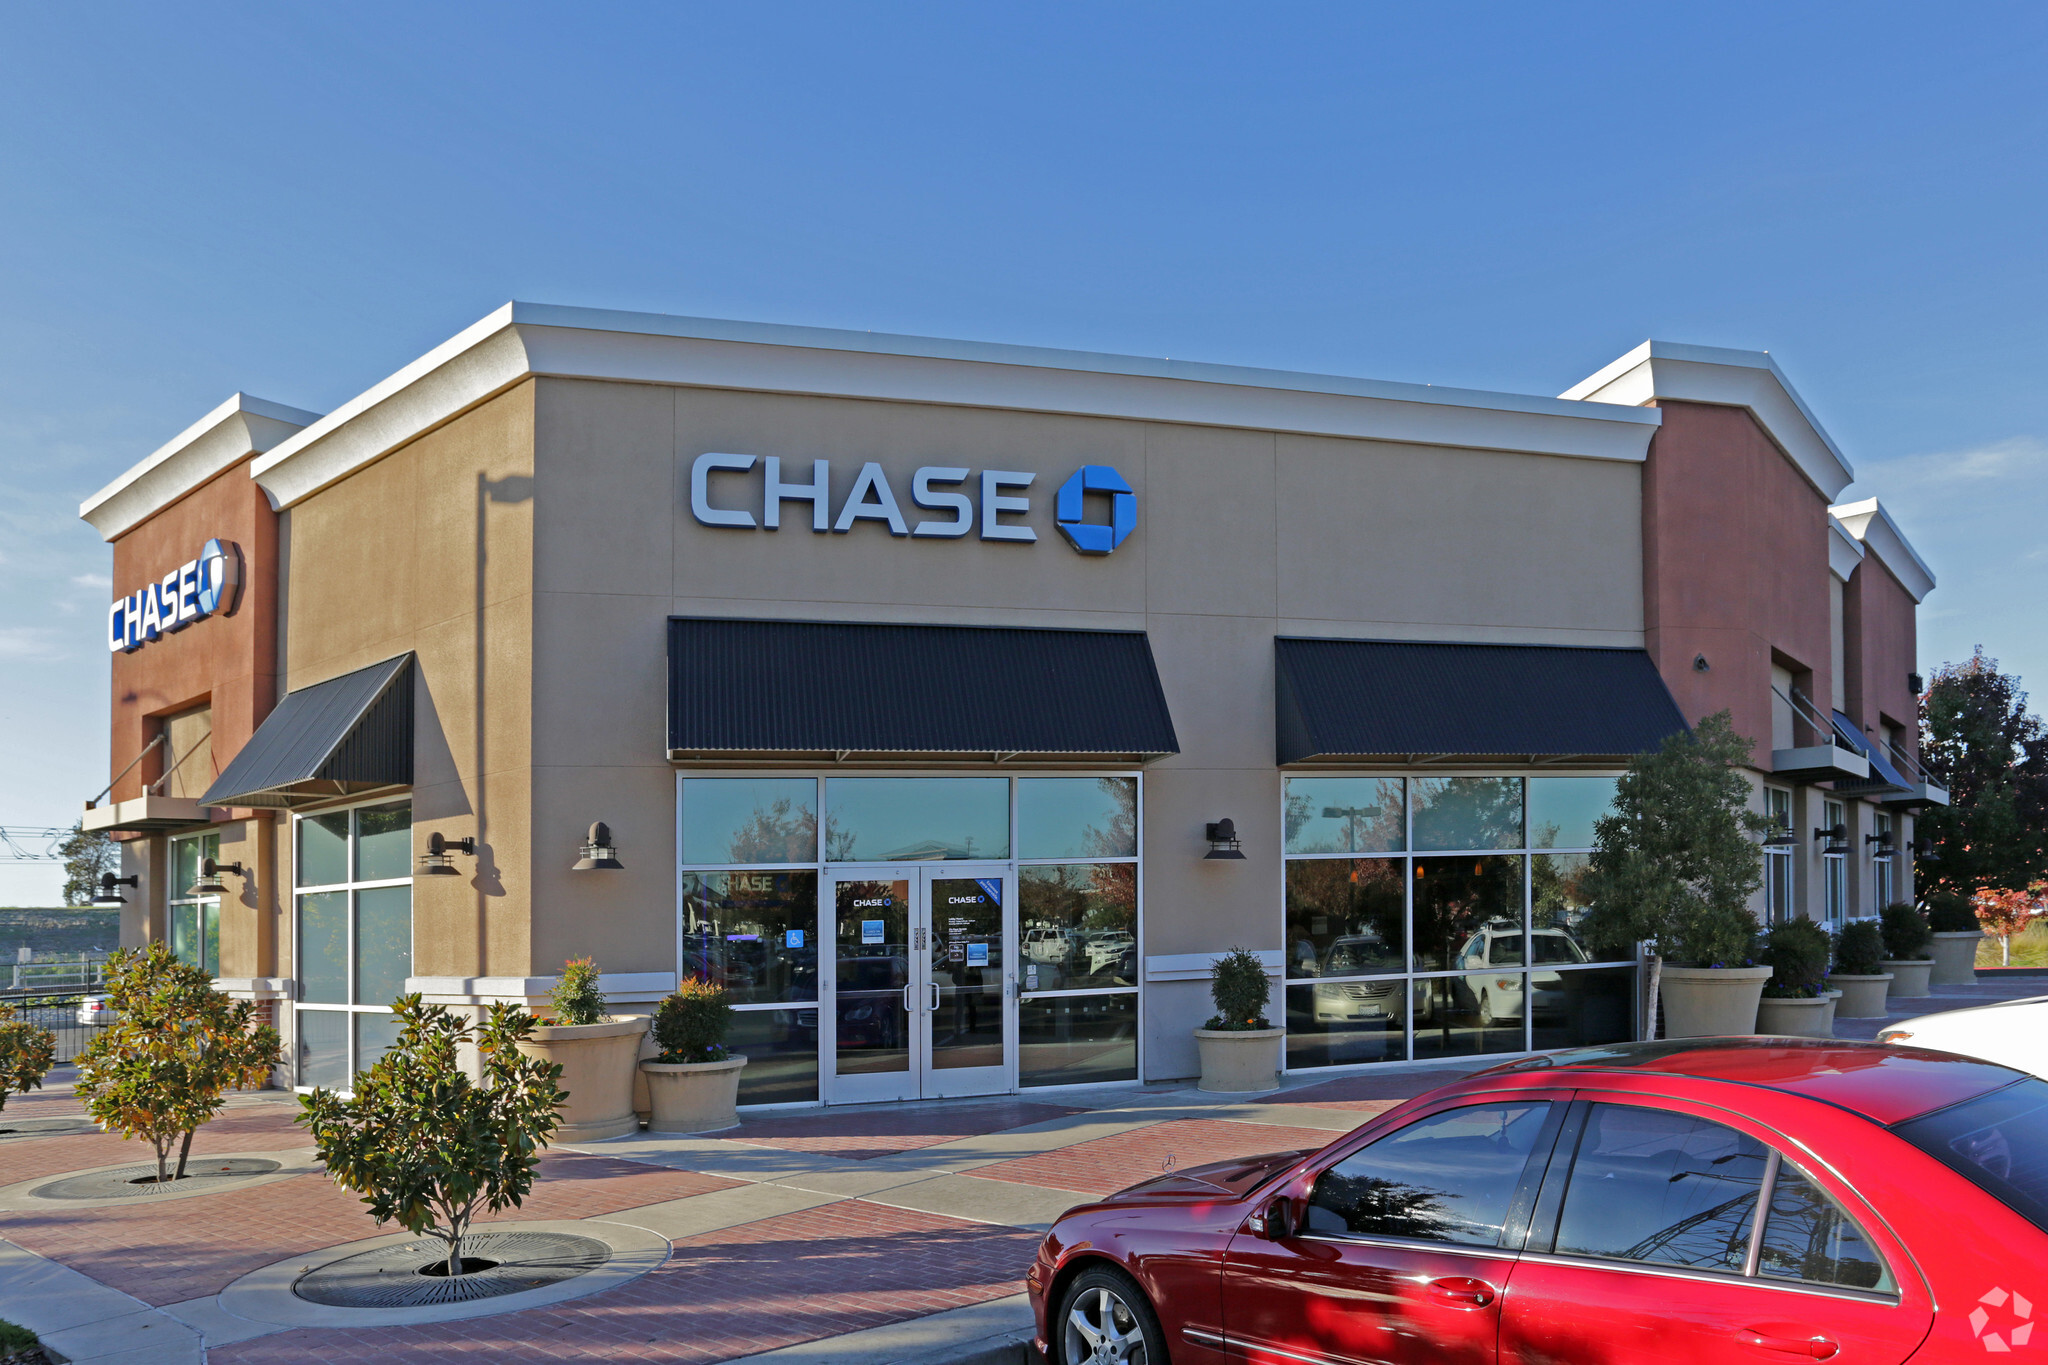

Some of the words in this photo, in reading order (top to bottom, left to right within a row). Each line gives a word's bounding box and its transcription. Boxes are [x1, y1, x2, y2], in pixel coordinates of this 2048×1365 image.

[690, 452, 1037, 543] CHASE
[108, 559, 197, 653] CHASE
[853, 899, 883, 907] CHASE
[948, 896, 977, 904] CHASE
